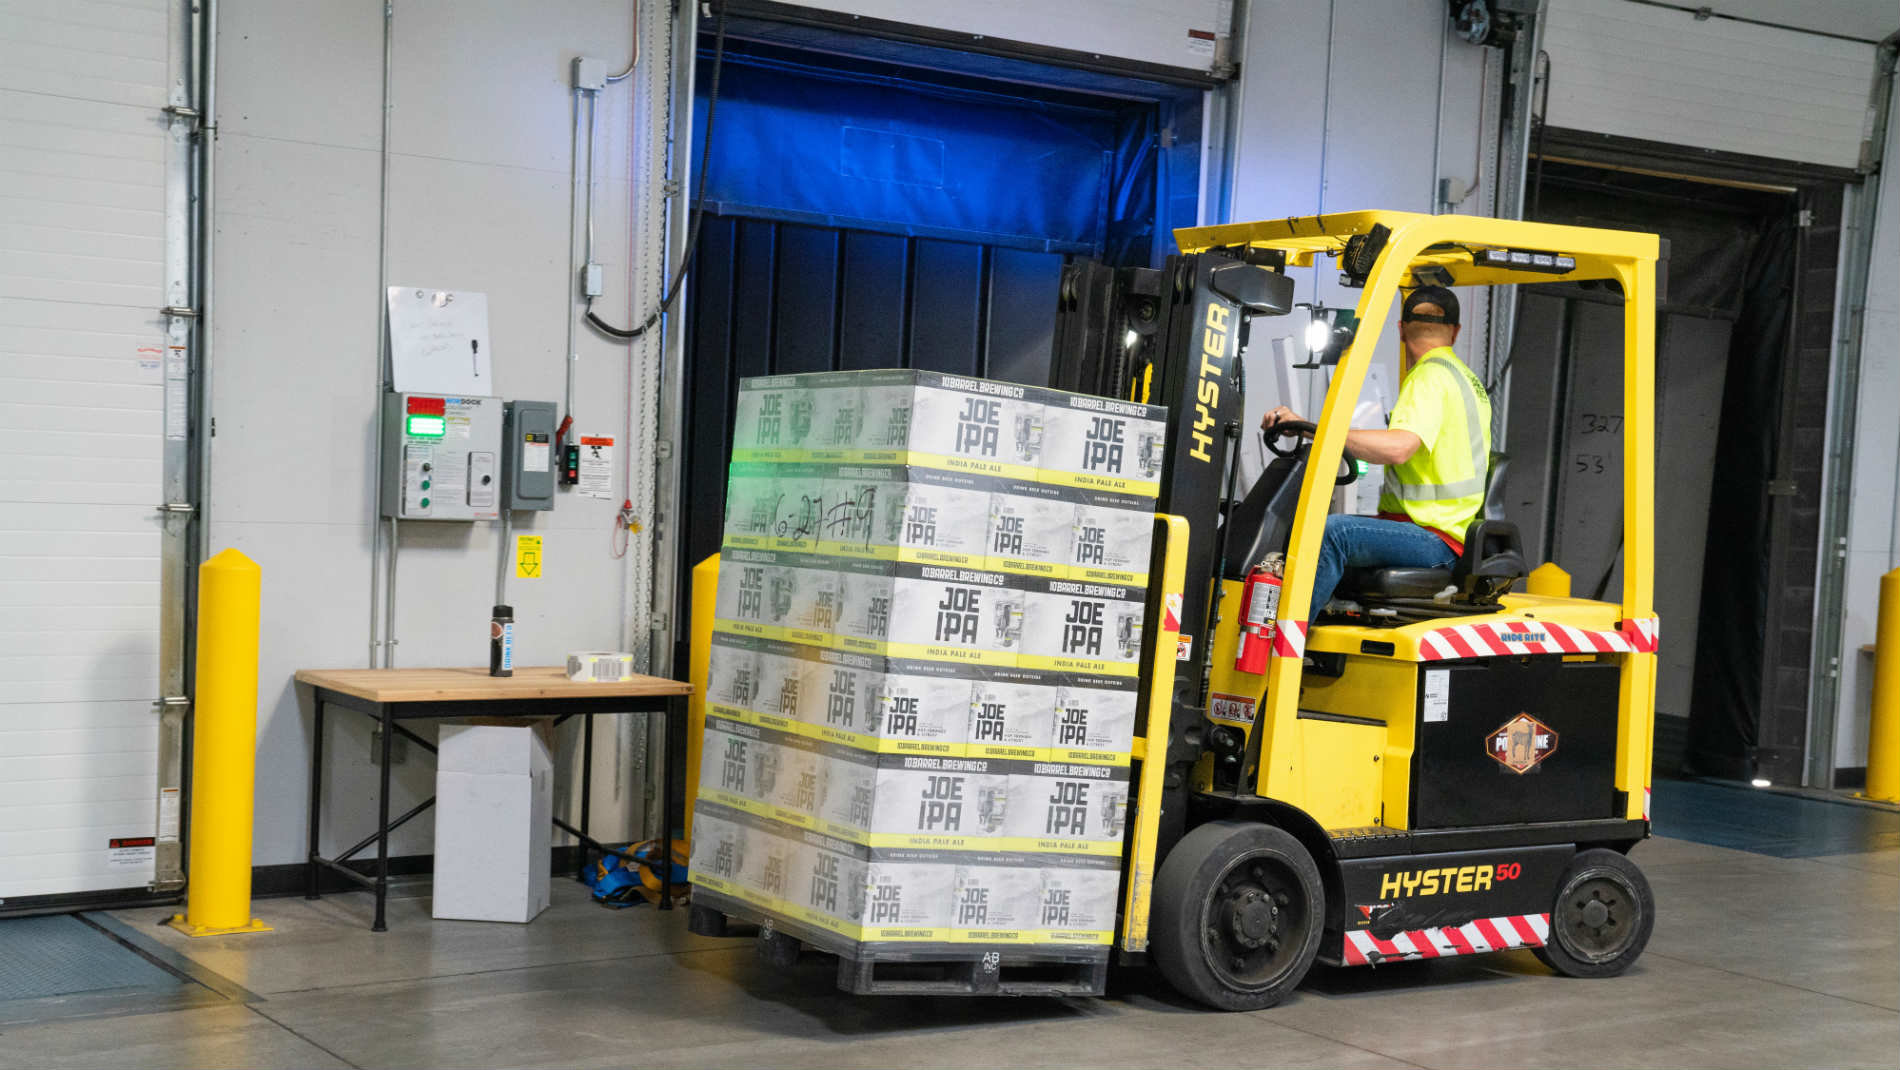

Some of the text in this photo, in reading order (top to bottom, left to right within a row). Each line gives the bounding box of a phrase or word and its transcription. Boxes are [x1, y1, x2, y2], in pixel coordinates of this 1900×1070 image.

[1189, 302, 1230, 463] HYSTER
[959, 398, 1002, 425] JOE
[756, 417, 781, 445] IPA
[887, 425, 907, 446] IPA
[955, 423, 1000, 457] IPA
[1086, 417, 1126, 443] JOE
[947, 459, 1002, 472] INDIA PALE ALE
[1082, 440, 1124, 473] IPA
[1074, 476, 1126, 489] INDIA PALE ALE
[908, 505, 937, 524] JOE
[996, 516, 1024, 533] JOE
[905, 522, 936, 545] IPA
[994, 532, 1023, 555] IPA
[1079, 526, 1105, 544] JOE
[1076, 542, 1104, 564] IPA
[740, 567, 764, 589] JOE
[737, 590, 761, 618] IPA
[816, 591, 834, 608] JOE
[869, 597, 888, 615] JOE
[939, 587, 982, 612] JOE
[813, 607, 832, 628] IPA
[1065, 600, 1105, 625] JOE
[866, 614, 887, 636] IPA
[934, 611, 980, 644] IPA
[1062, 624, 1104, 655] IPA
[926, 648, 982, 659] INDIA PALE ALE
[1054, 659, 1105, 670] INDIA PALE ALE
[734, 669, 751, 686] JOE
[781, 677, 799, 695] JOE
[829, 669, 857, 696] JOE
[731, 684, 750, 706] IPA
[779, 693, 798, 716] IPA
[889, 696, 919, 715] JOE
[826, 694, 855, 728] IPA
[977, 703, 1006, 721] JOE
[1061, 708, 1088, 726] JOE
[887, 713, 918, 736] IPA
[975, 719, 1004, 741] IPA
[1059, 724, 1087, 746] IPA
[724, 738, 747, 763] JOE
[721, 760, 746, 793] IPA
[921, 775, 964, 800] JOE
[1049, 782, 1090, 805] JOE
[917, 800, 962, 831] IPA
[1045, 805, 1088, 835] IPA
[951, 838, 964, 846] ALE
[1038, 841, 1058, 849] INDIA
[1077, 842, 1089, 850] ALE
[714, 856, 732, 878] IPA
[814, 852, 840, 881] JOE
[1379, 862, 1521, 900] HYSTER 50
[810, 876, 837, 912] IPA
[873, 885, 902, 902] JOE
[961, 887, 989, 905] JOE
[1044, 889, 1071, 906] JOE
[870, 902, 900, 924] IPA
[958, 904, 988, 925] IPA
[1041, 905, 1069, 927] IPA
[982, 951, 1000, 963] AB
